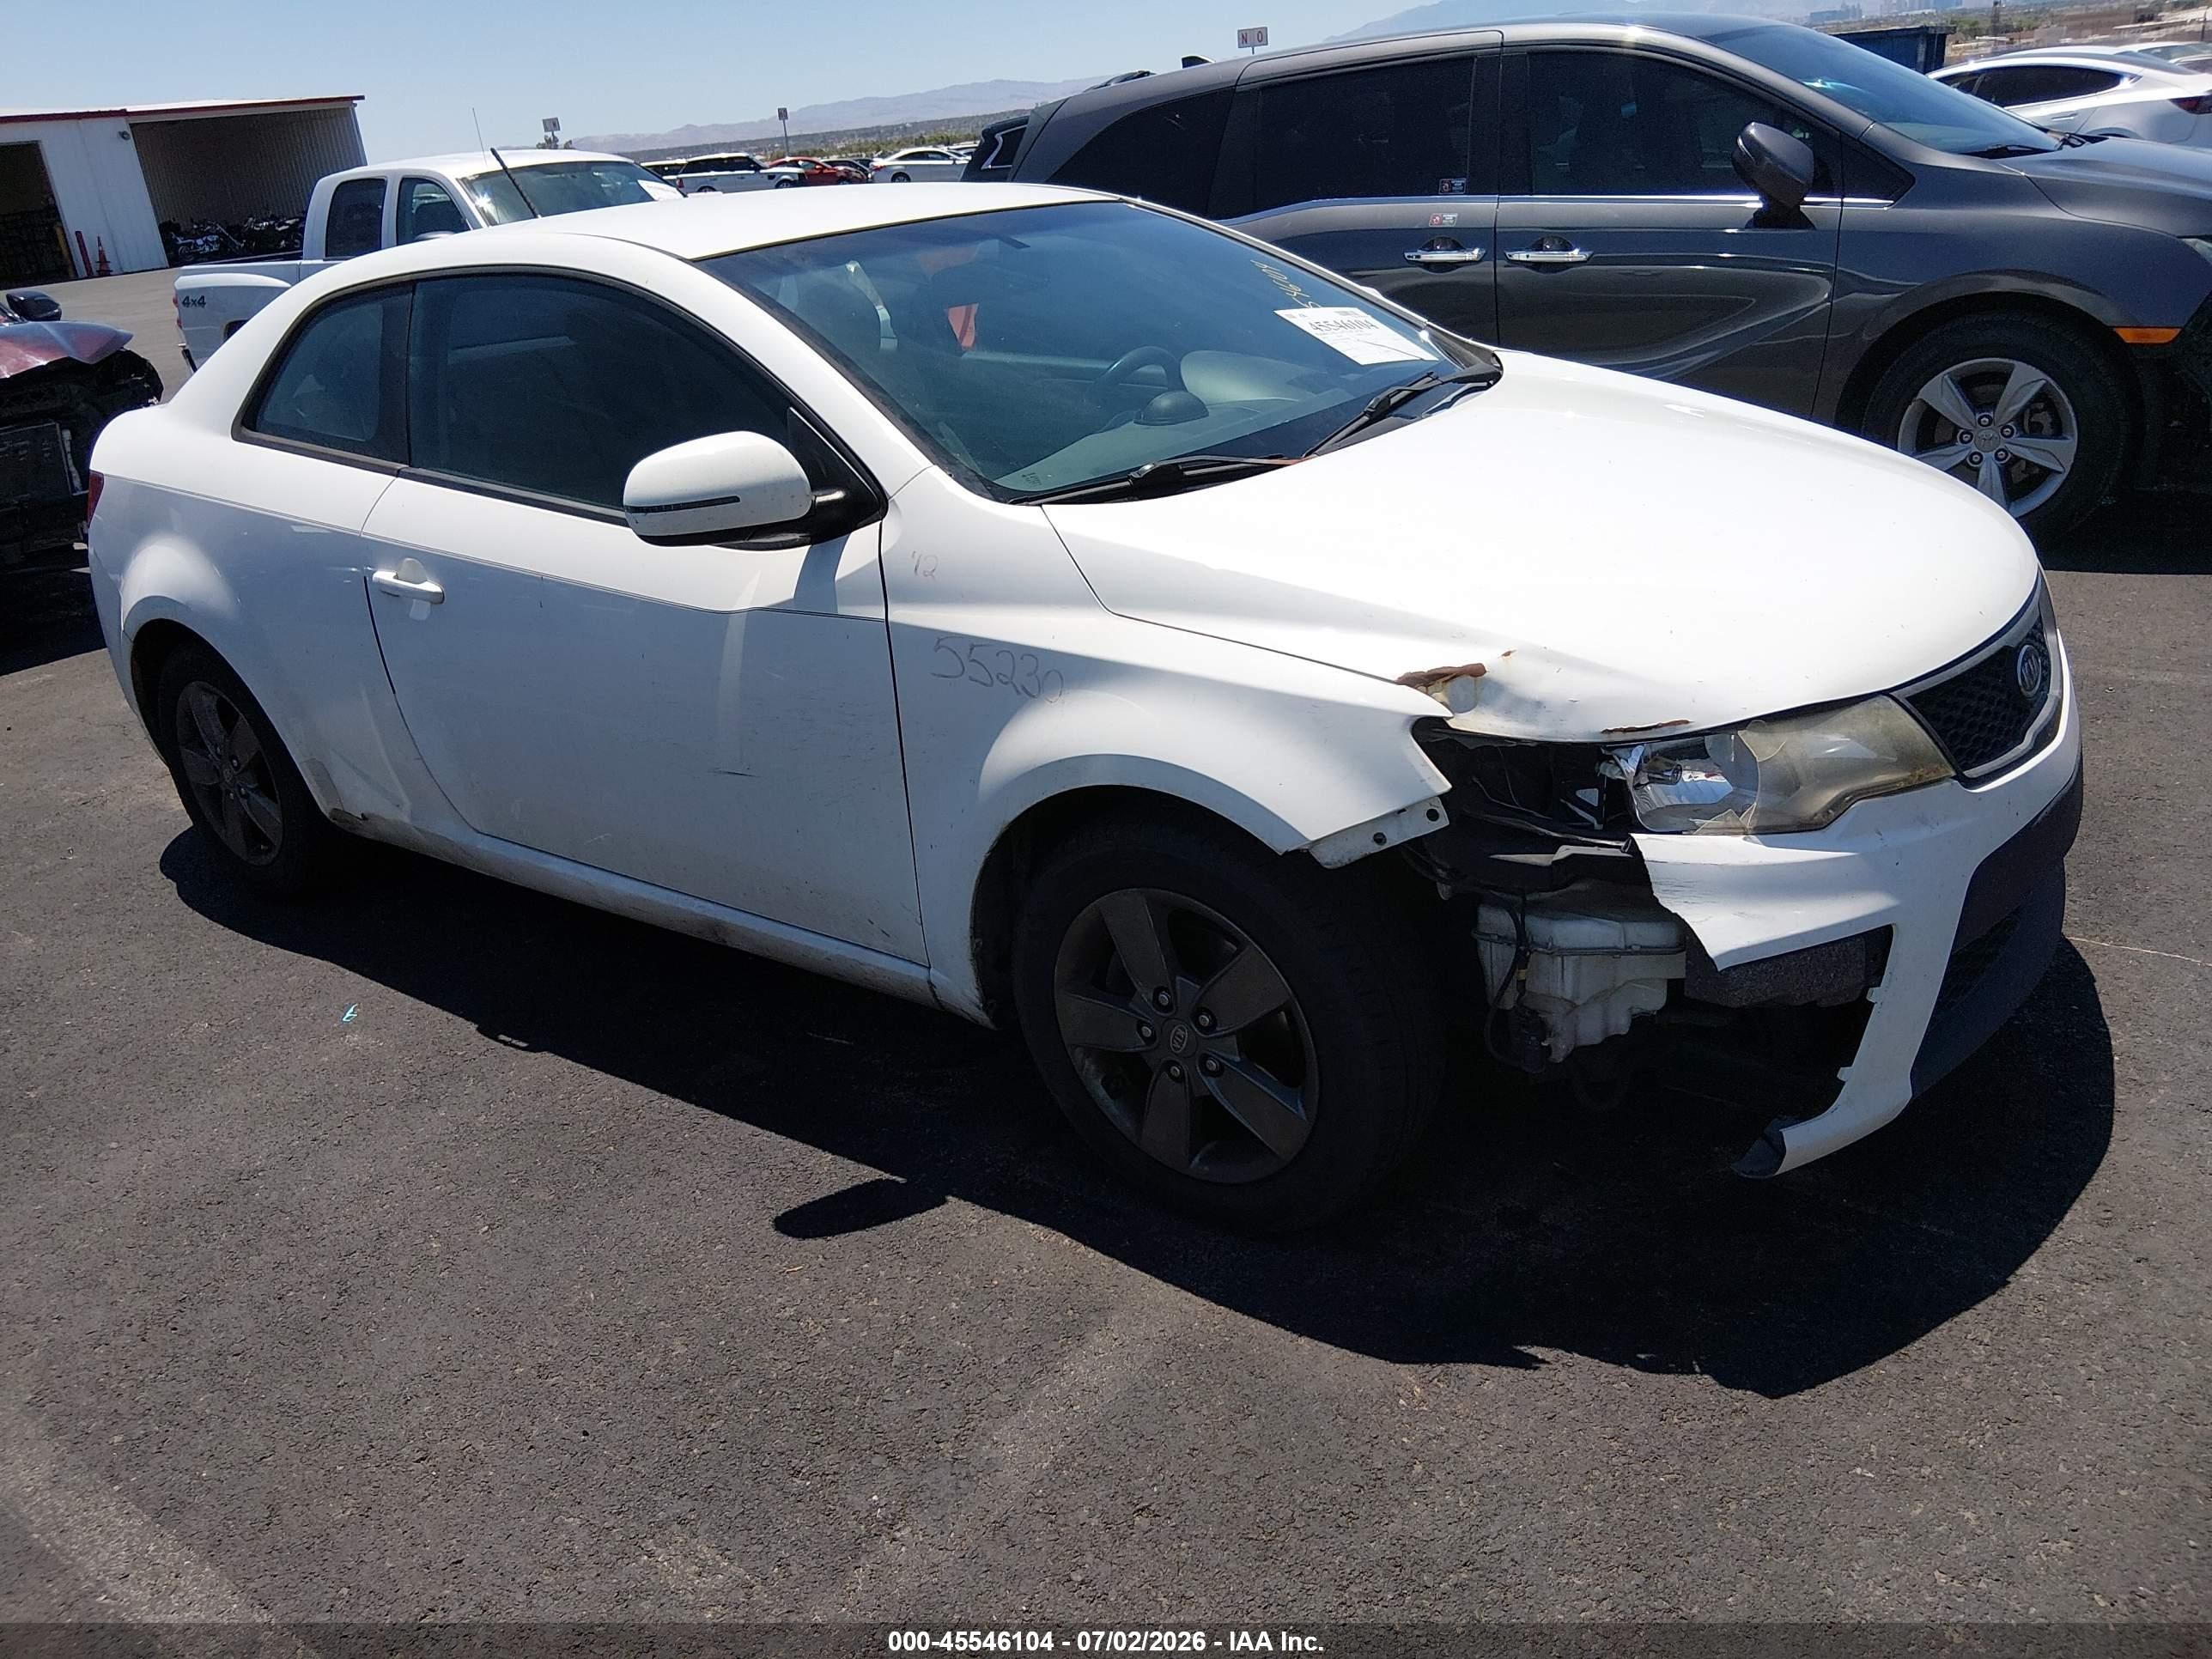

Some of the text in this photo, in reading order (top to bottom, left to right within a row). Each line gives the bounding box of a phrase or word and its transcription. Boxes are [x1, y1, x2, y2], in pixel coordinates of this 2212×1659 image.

[1241, 33, 1248, 44] N
[182, 295, 207, 308] 4x4
[930, 634, 1065, 704] 55230
